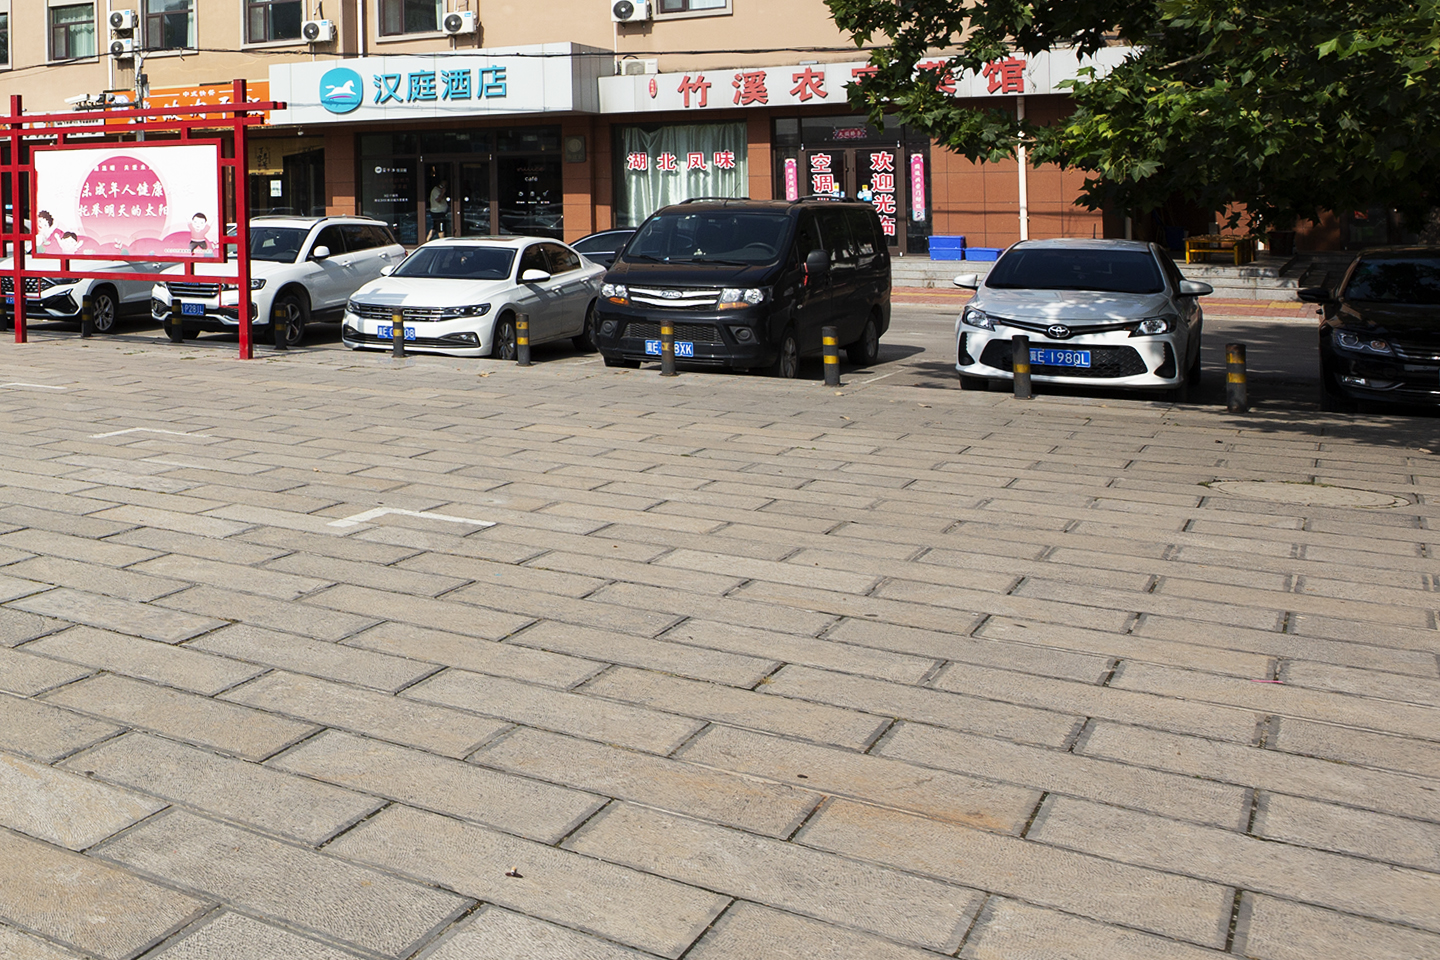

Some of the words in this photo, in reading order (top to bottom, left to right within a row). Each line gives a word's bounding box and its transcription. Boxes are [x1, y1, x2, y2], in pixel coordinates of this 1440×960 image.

[372, 64, 508, 104] 汉庭酒店
[810, 152, 835, 201] 空调
[870, 151, 897, 236] 欢迎光临
[77, 203, 169, 218] 托举明天的太阳
